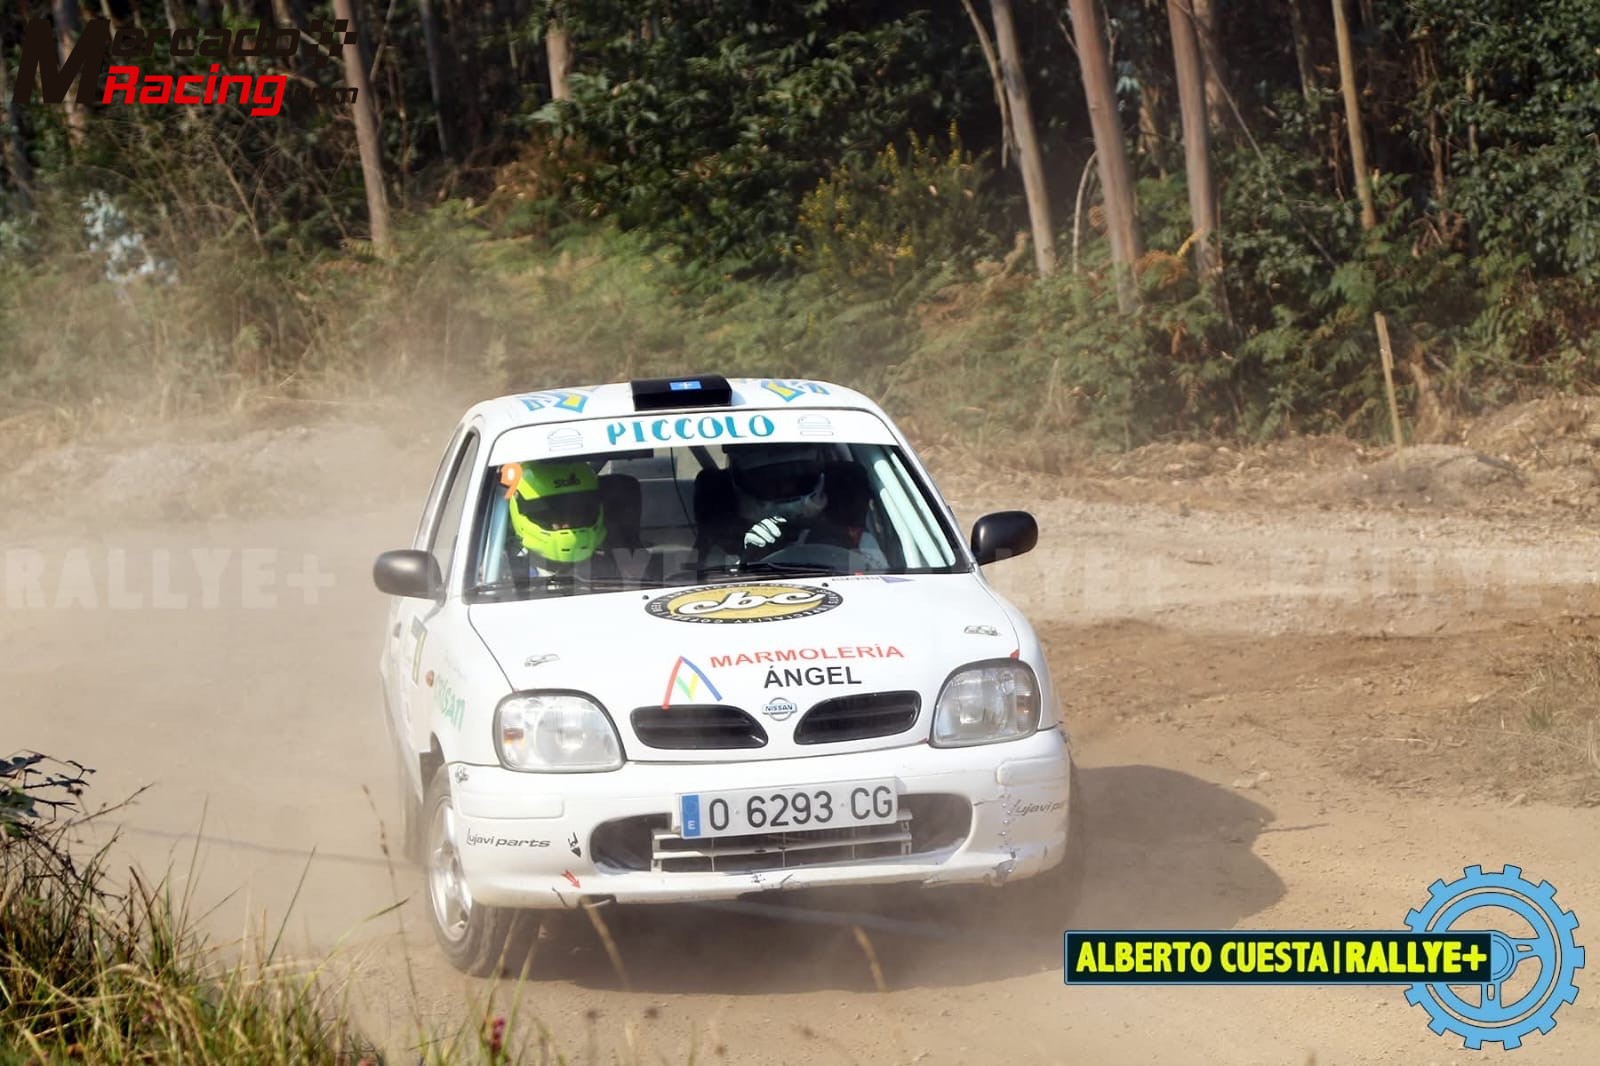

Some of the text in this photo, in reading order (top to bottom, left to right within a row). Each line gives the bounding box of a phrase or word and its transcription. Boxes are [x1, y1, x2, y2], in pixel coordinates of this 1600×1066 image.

[606, 414, 775, 446] PICCOLO
[499, 462, 523, 500] 9
[764, 665, 862, 688] ÁNGEL
[765, 703, 793, 712] NISSAN
[746, 791, 834, 829] 6293
[850, 786, 893, 819] CG
[495, 837, 552, 848] parts
